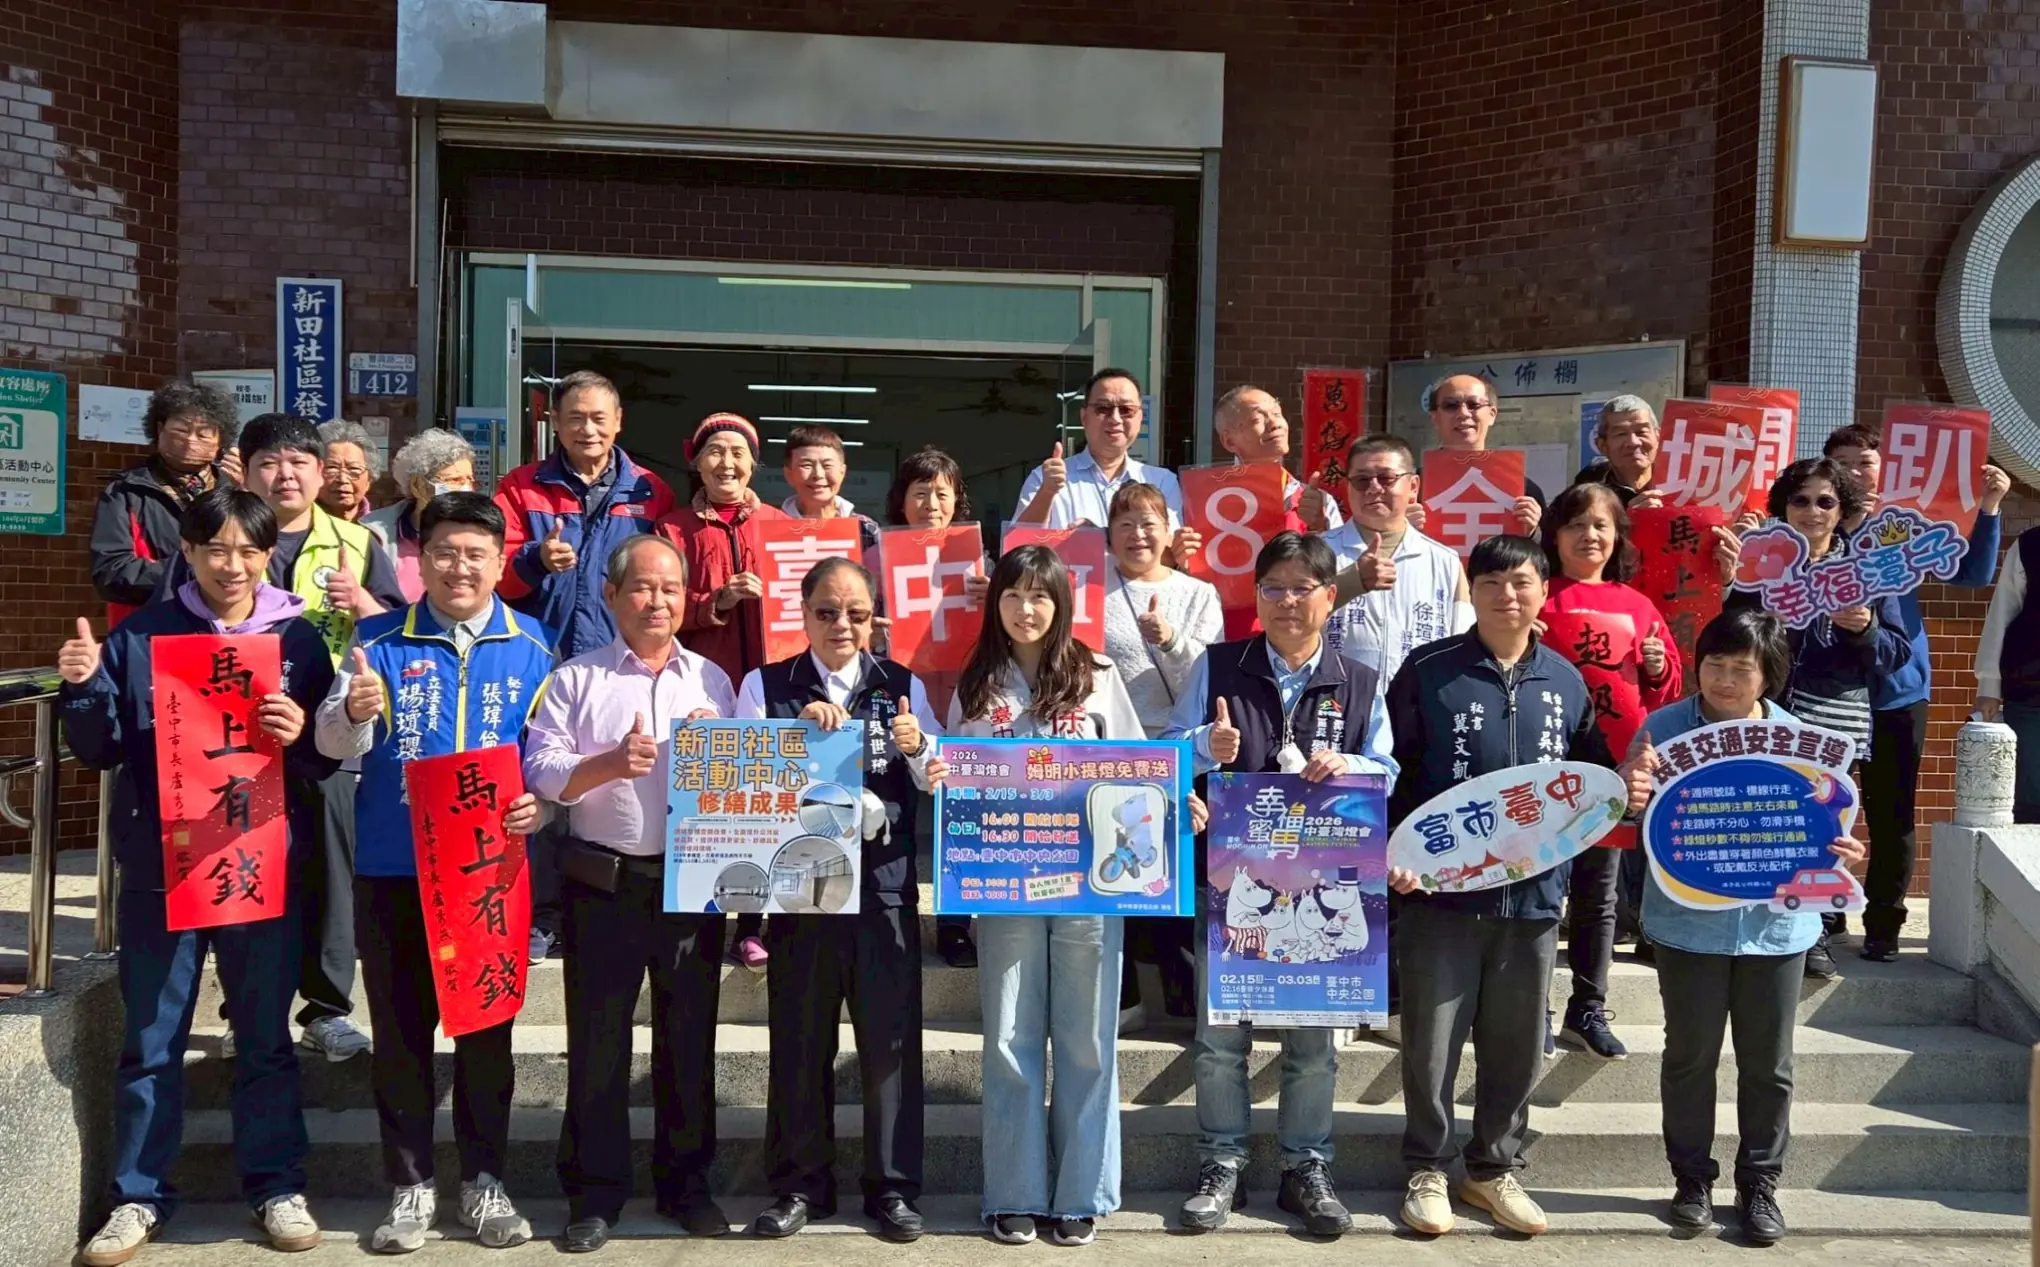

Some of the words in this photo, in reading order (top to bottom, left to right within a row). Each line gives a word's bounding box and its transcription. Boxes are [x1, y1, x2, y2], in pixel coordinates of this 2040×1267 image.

[292, 287, 328, 424] 新田社區發
[365, 372, 408, 395] 412
[31, 476, 56, 485] Center
[1655, 419, 1756, 516] 城
[1880, 423, 1978, 513] 趴
[1424, 466, 1517, 557] 全
[1205, 487, 1265, 575] 8
[1769, 527, 1959, 622] 幸福潭子
[893, 545, 979, 642] 中
[1412, 600, 1434, 644] 徐瑄
[425, 675, 442, 731] 立法委員
[673, 726, 809, 759] 新田社區
[952, 751, 978, 760] 2026
[1652, 725, 1849, 785] 長者交通安全宣導
[199, 646, 265, 907] 馬上有錢
[673, 759, 809, 792] 活動中心
[949, 763, 1011, 777] 中臺灣燈會
[1026, 760, 1170, 781] 姆明小提燈免費送
[697, 791, 799, 815] 修繕成果
[985, 788, 1018, 800] 2/15
[1030, 788, 1054, 801] 3/3
[981, 812, 1020, 826] 16:00
[1305, 817, 1343, 826] 2026
[1413, 769, 1584, 856] 富市臺中
[981, 830, 1020, 843] 16:30
[1304, 826, 1372, 837] 中臺灣燈會
[448, 762, 525, 1010] 馬上有錢
[1326, 976, 1363, 988] 臺中市
[1326, 988, 1375, 1000] 中央公園
